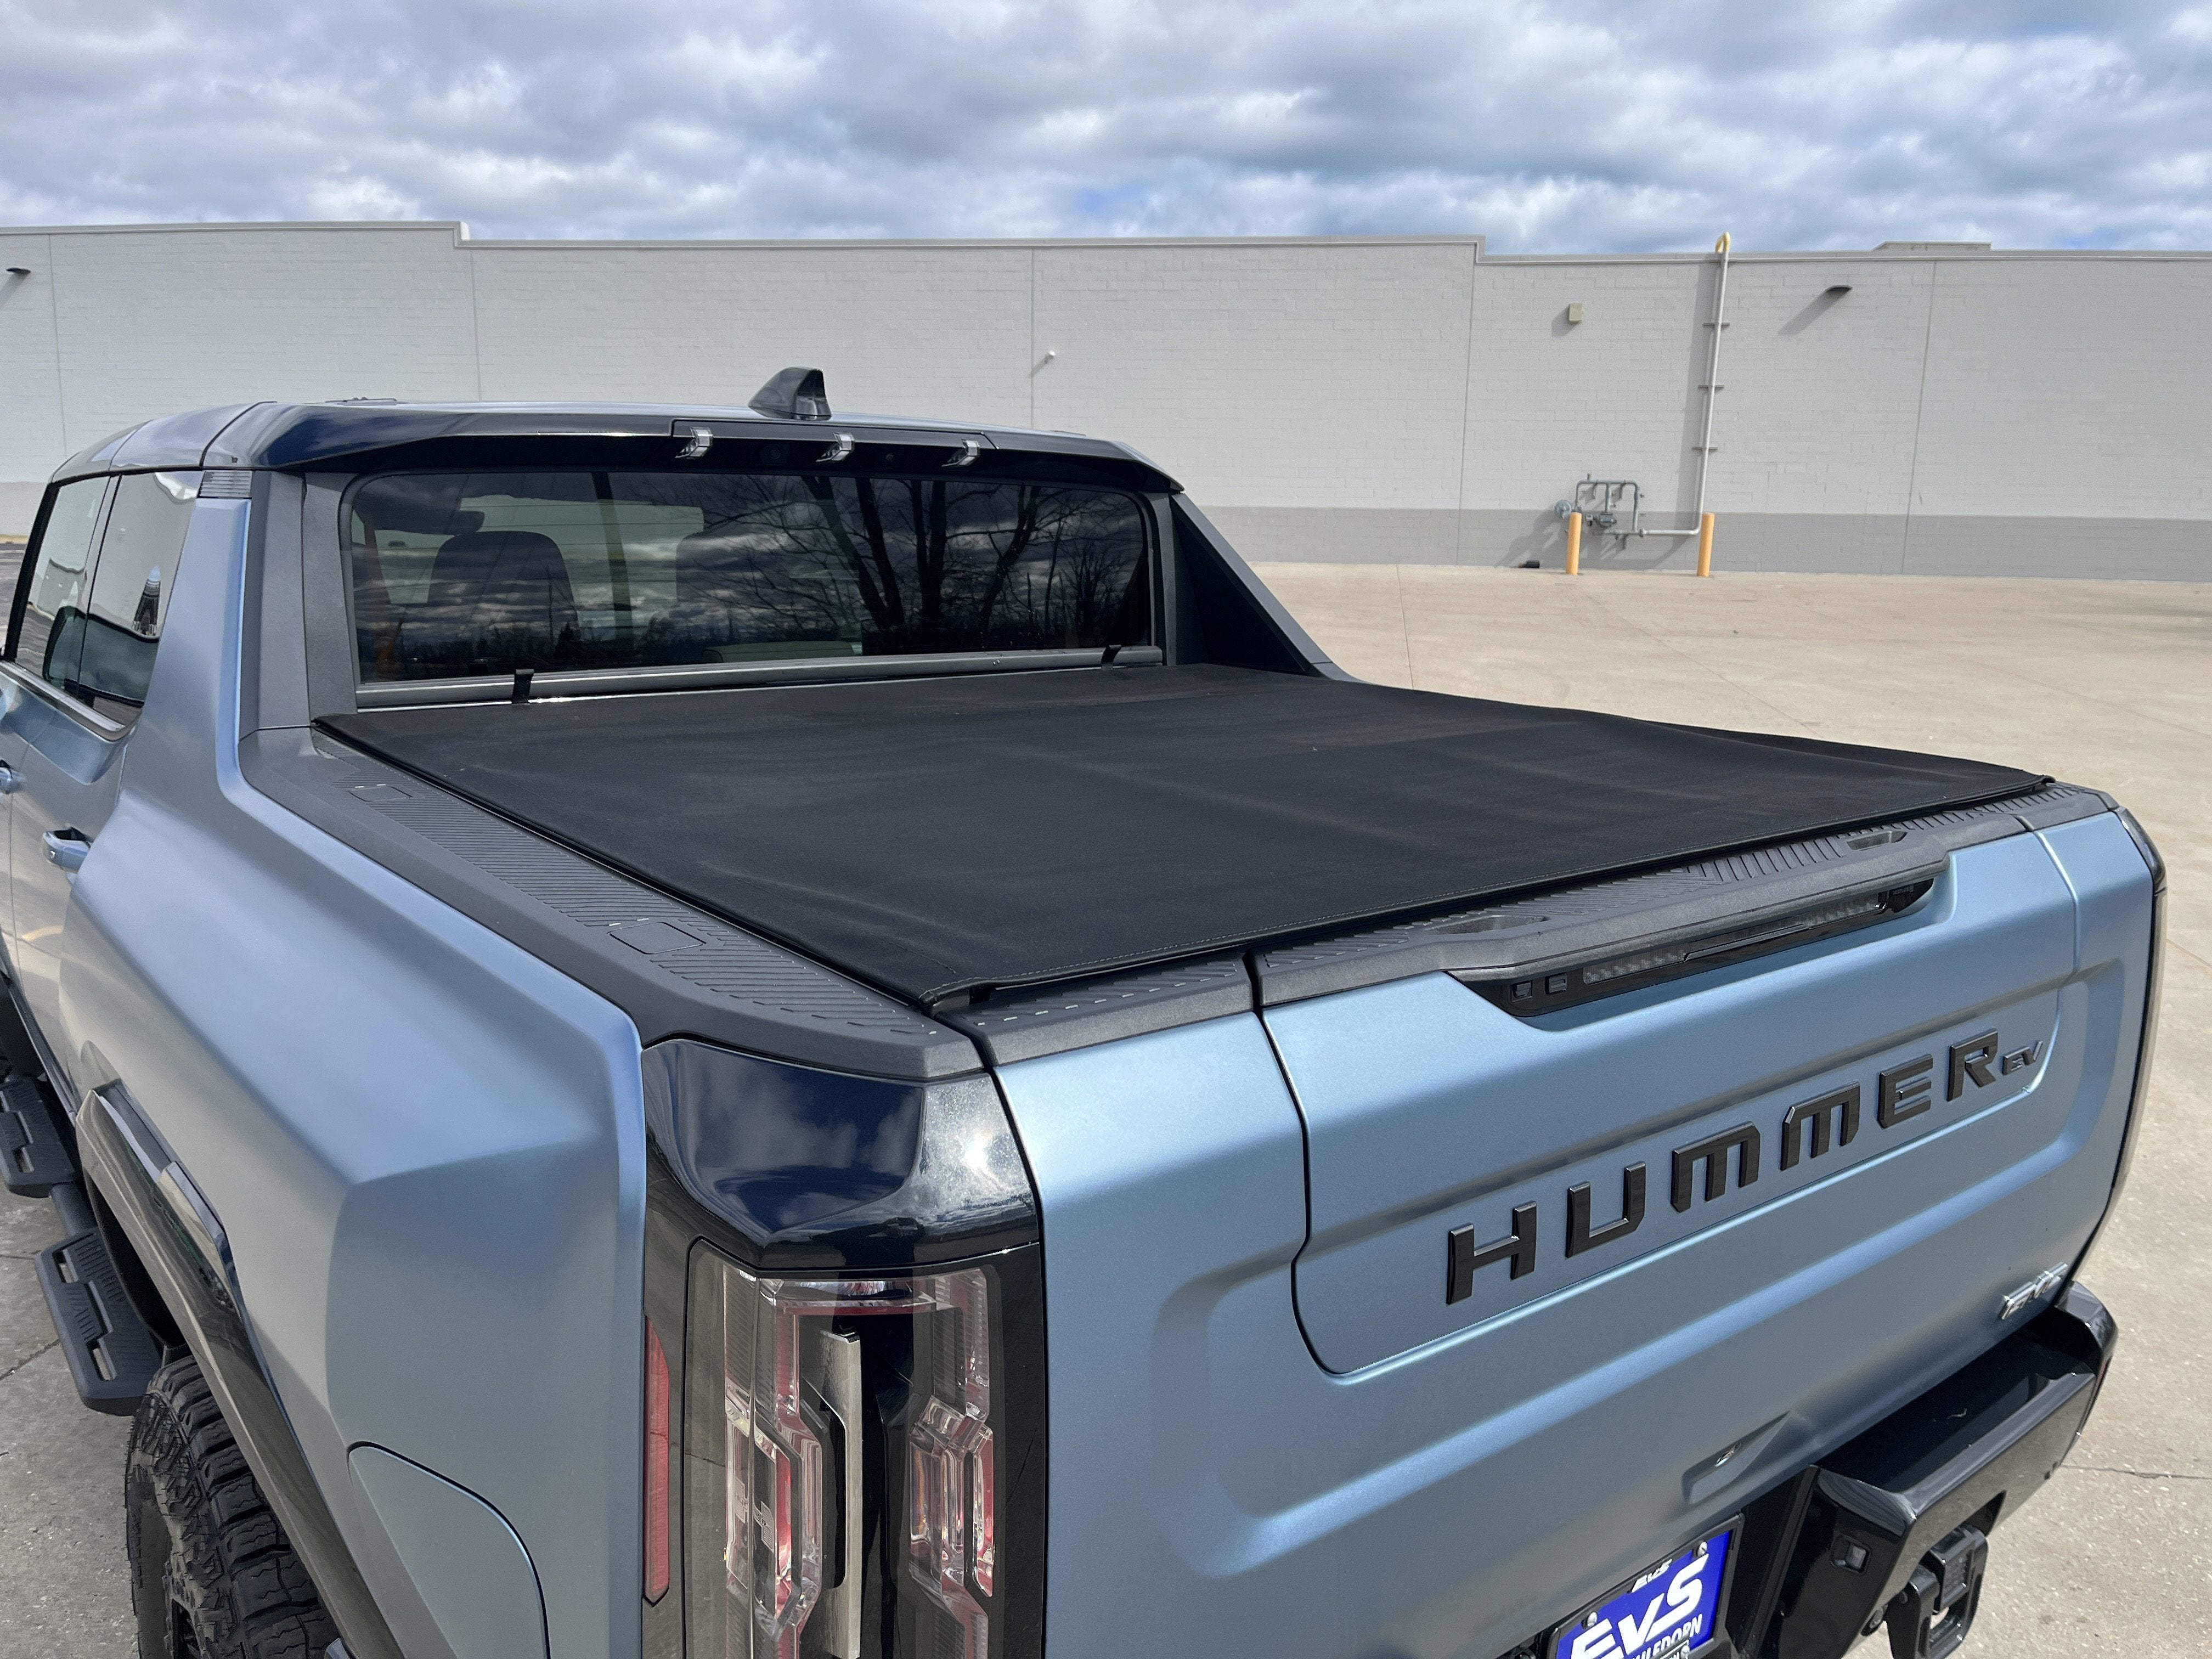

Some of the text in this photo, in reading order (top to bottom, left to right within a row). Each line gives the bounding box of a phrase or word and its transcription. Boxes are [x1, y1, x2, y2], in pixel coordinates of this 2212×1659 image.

[1446, 1028, 2043, 1305] HUMMER EV
[1570, 1553, 1709, 1659] EVS
[1631, 1559, 1673, 1593] EVS
